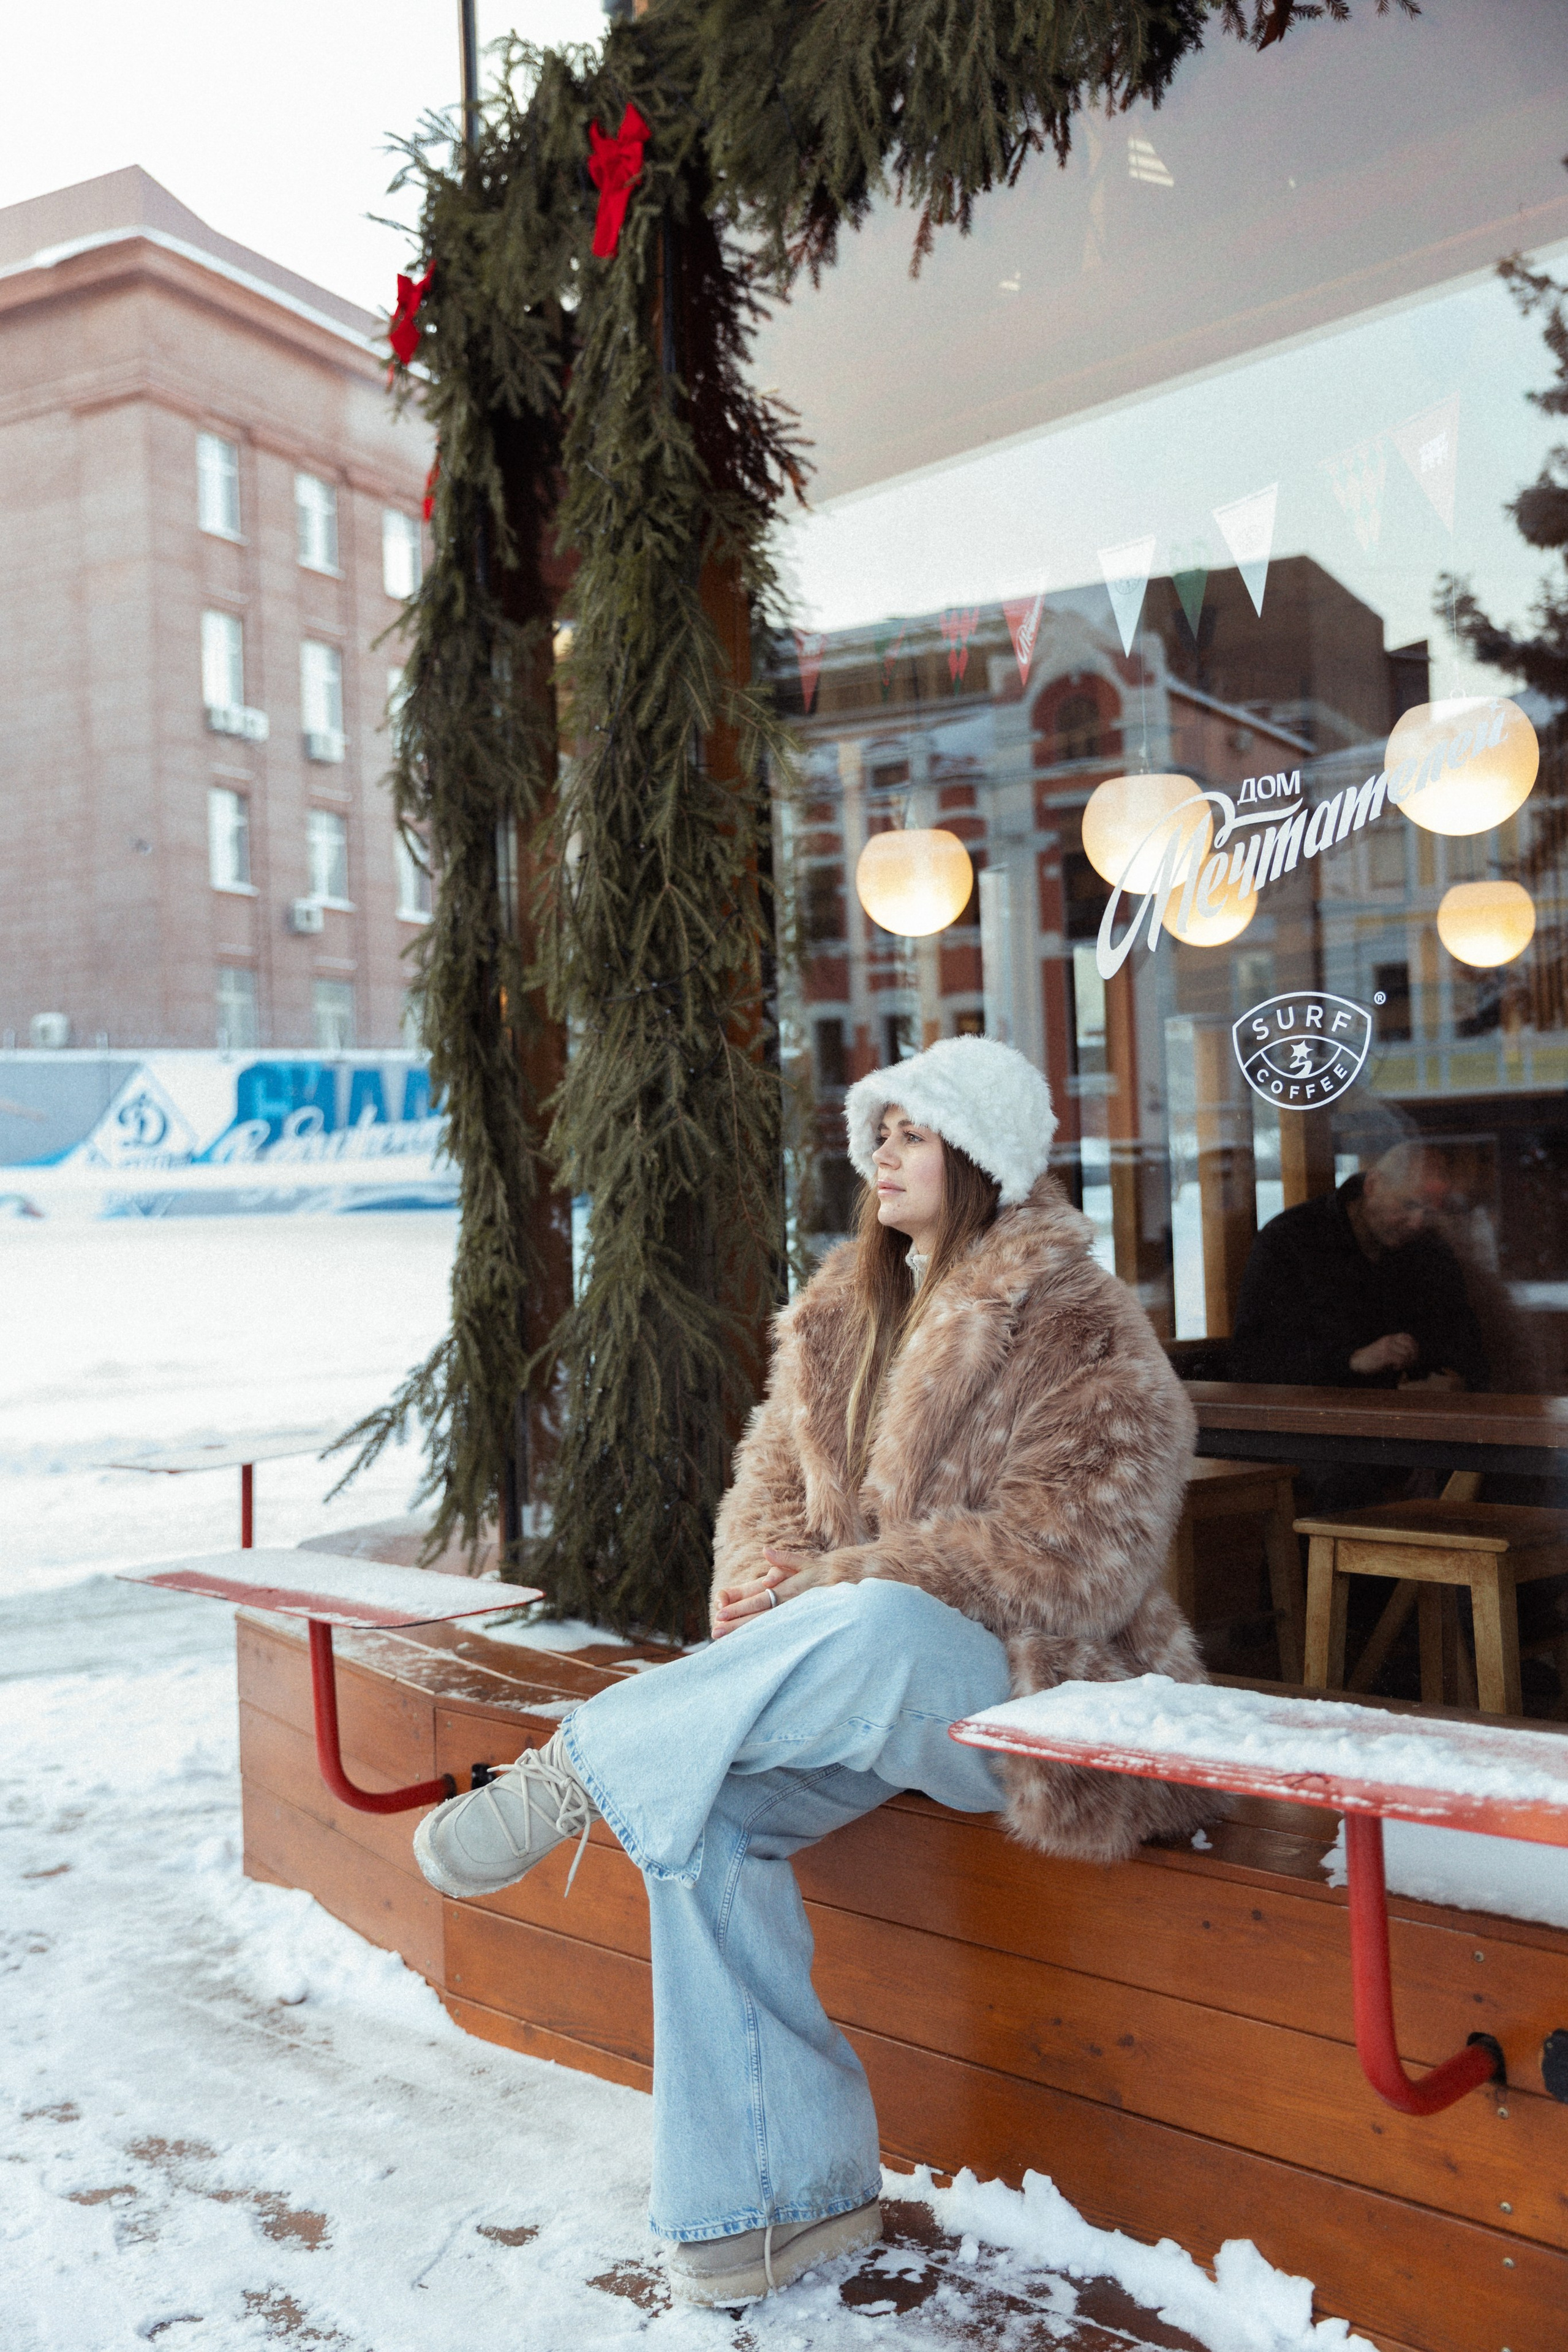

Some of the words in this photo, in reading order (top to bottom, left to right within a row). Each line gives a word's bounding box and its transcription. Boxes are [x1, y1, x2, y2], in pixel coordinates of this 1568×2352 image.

[1096, 699, 1509, 980] Мечтателей
[1252, 1005, 1352, 1040] SURF
[1256, 1063, 1348, 1099] COFFEE
